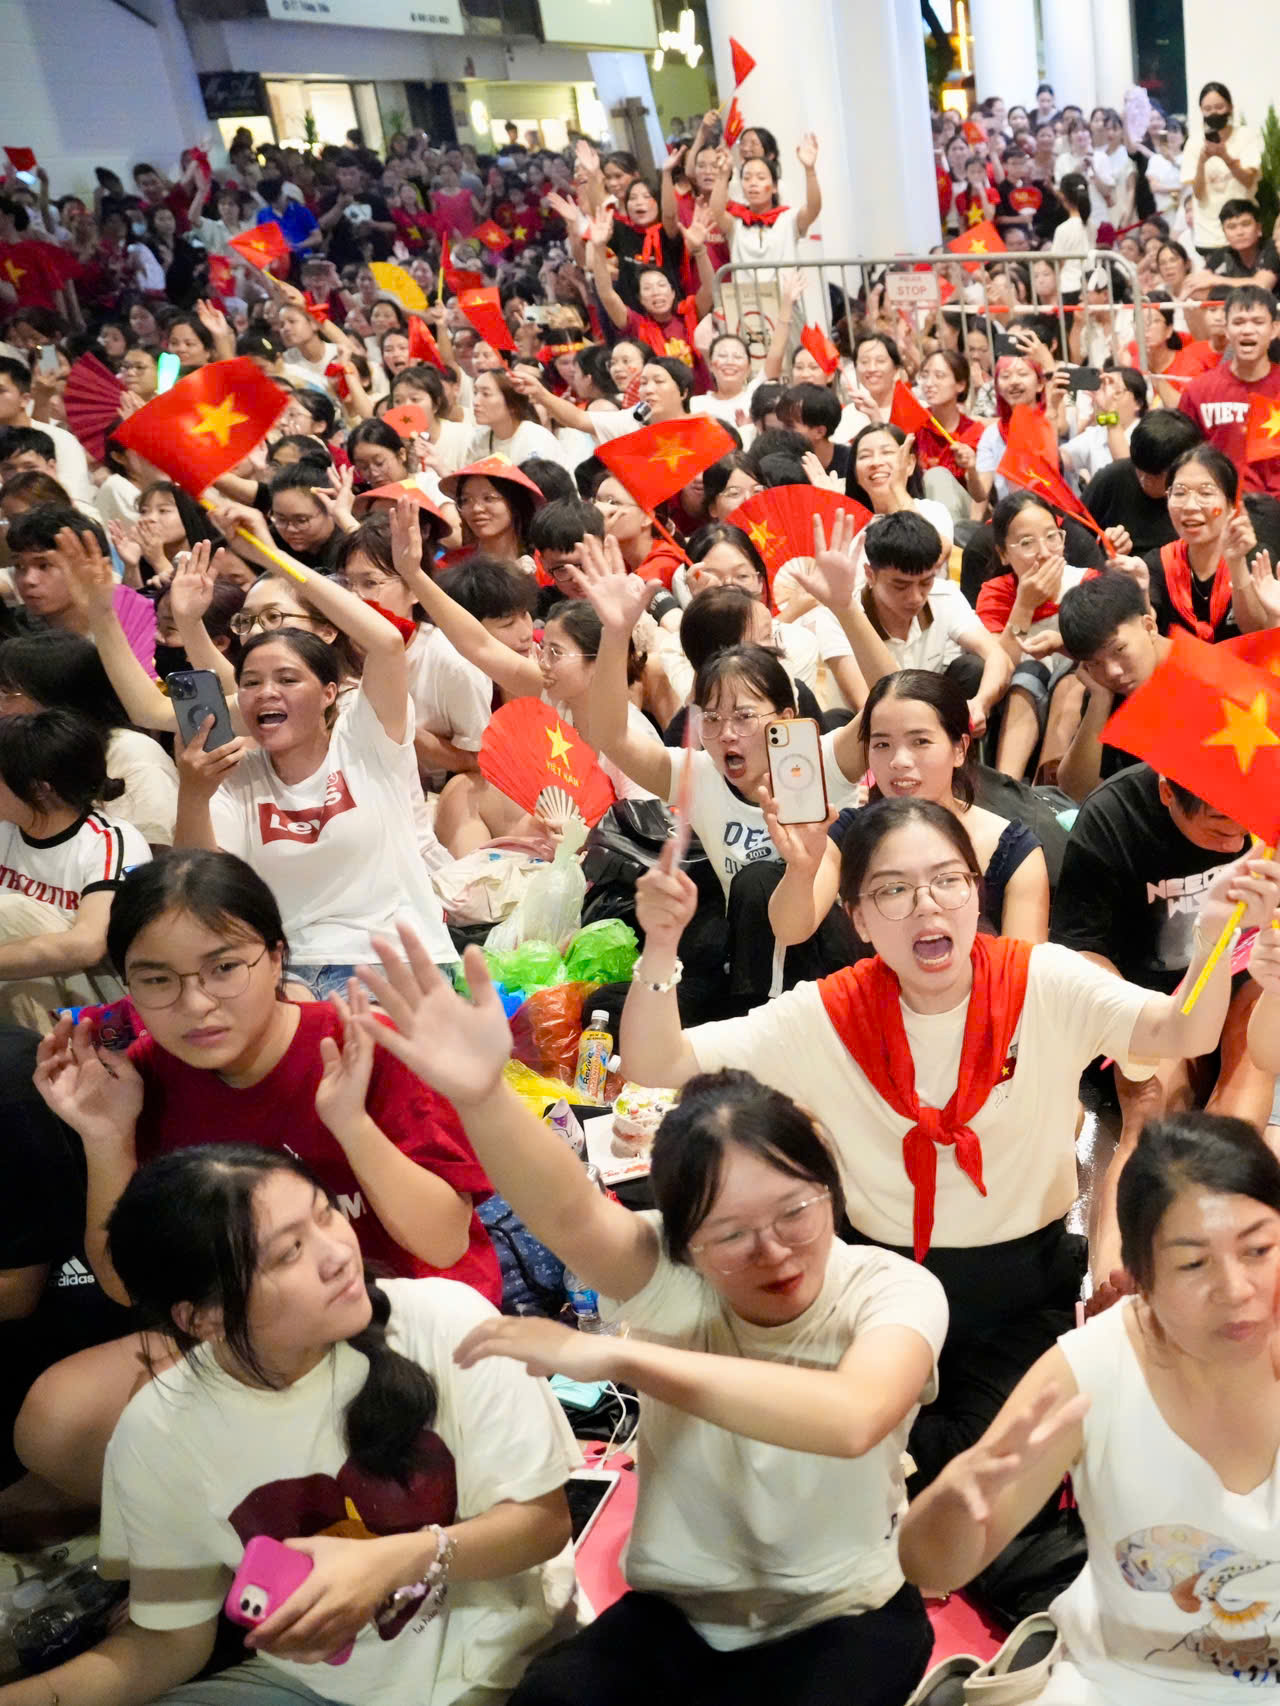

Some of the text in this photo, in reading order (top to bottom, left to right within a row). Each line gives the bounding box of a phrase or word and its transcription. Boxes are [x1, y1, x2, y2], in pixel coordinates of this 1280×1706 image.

[897, 285, 928, 296] STOP
[1200, 402, 1250, 429] VIET
[724, 821, 772, 851] DE
[583, 1051, 595, 1085] Revive
[57, 1273, 96, 1287] didas
